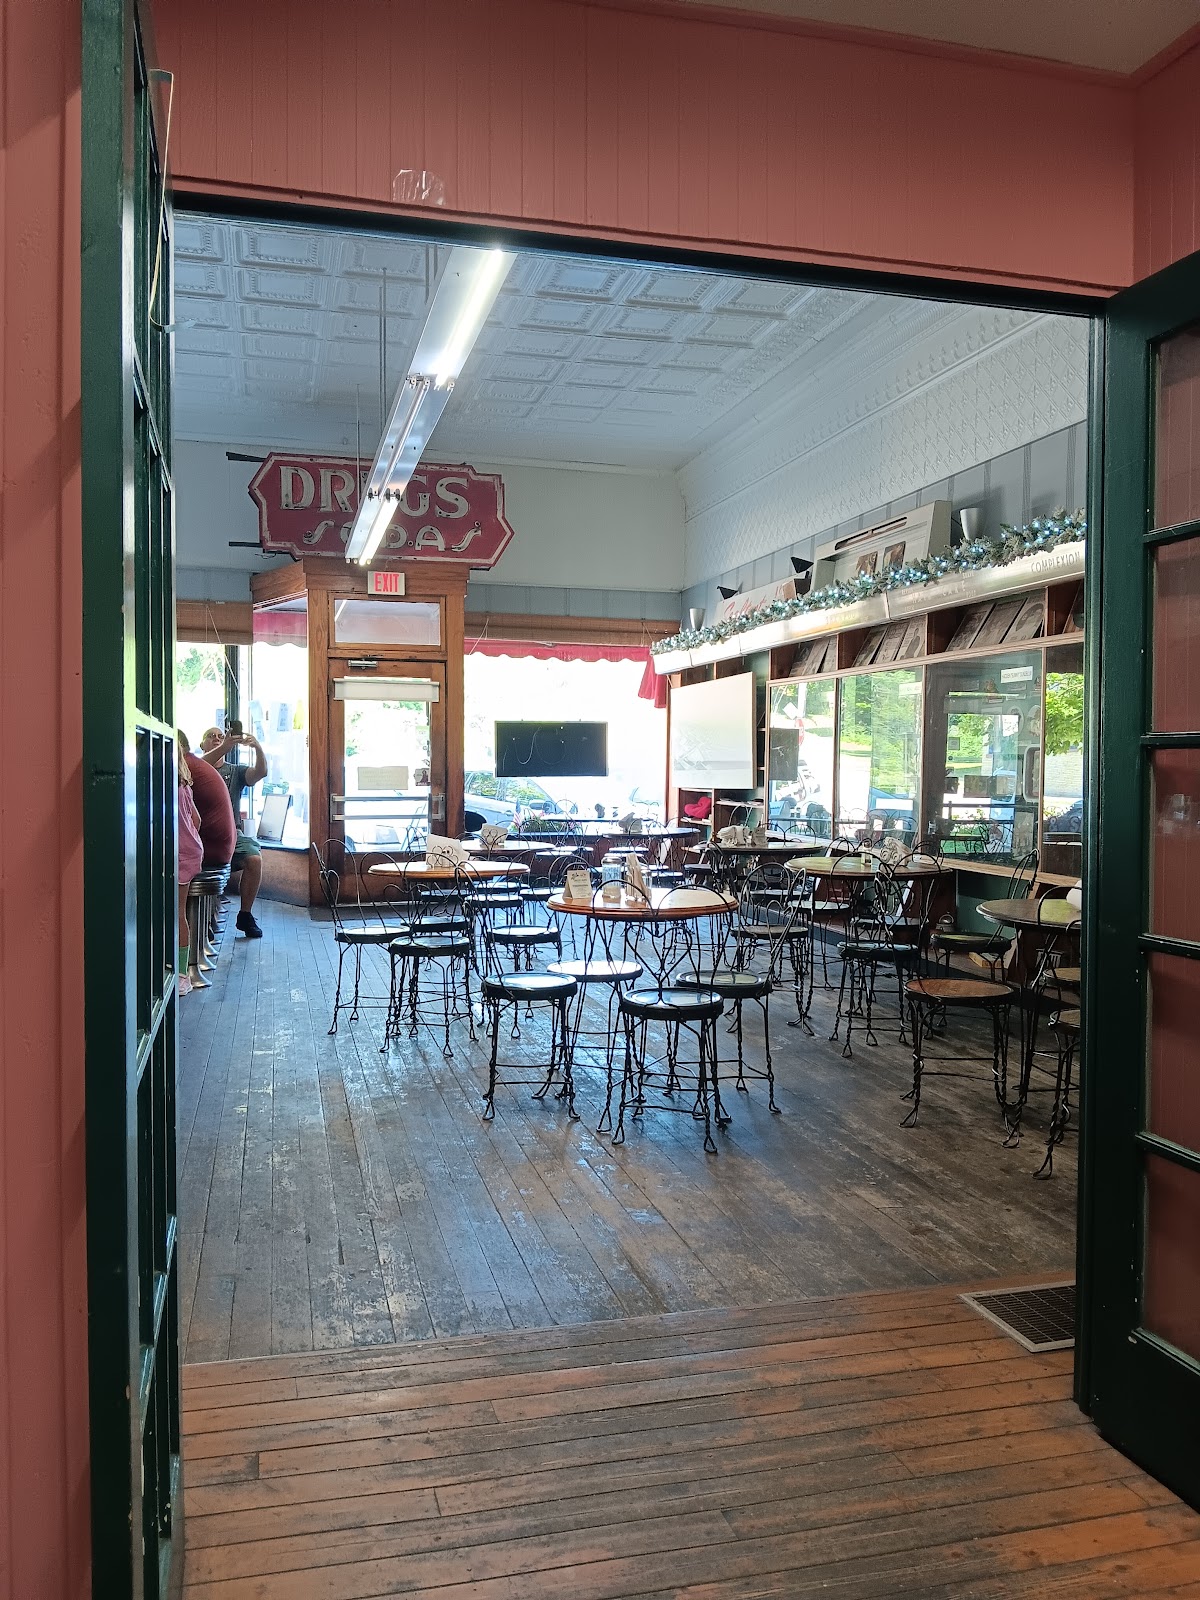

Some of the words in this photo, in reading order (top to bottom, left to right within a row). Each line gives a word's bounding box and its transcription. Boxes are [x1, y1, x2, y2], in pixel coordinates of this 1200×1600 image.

[279, 465, 471, 519] DRGS
[1031, 551, 1081, 573] COMPLEXION
[374, 572, 400, 592] EXIT
